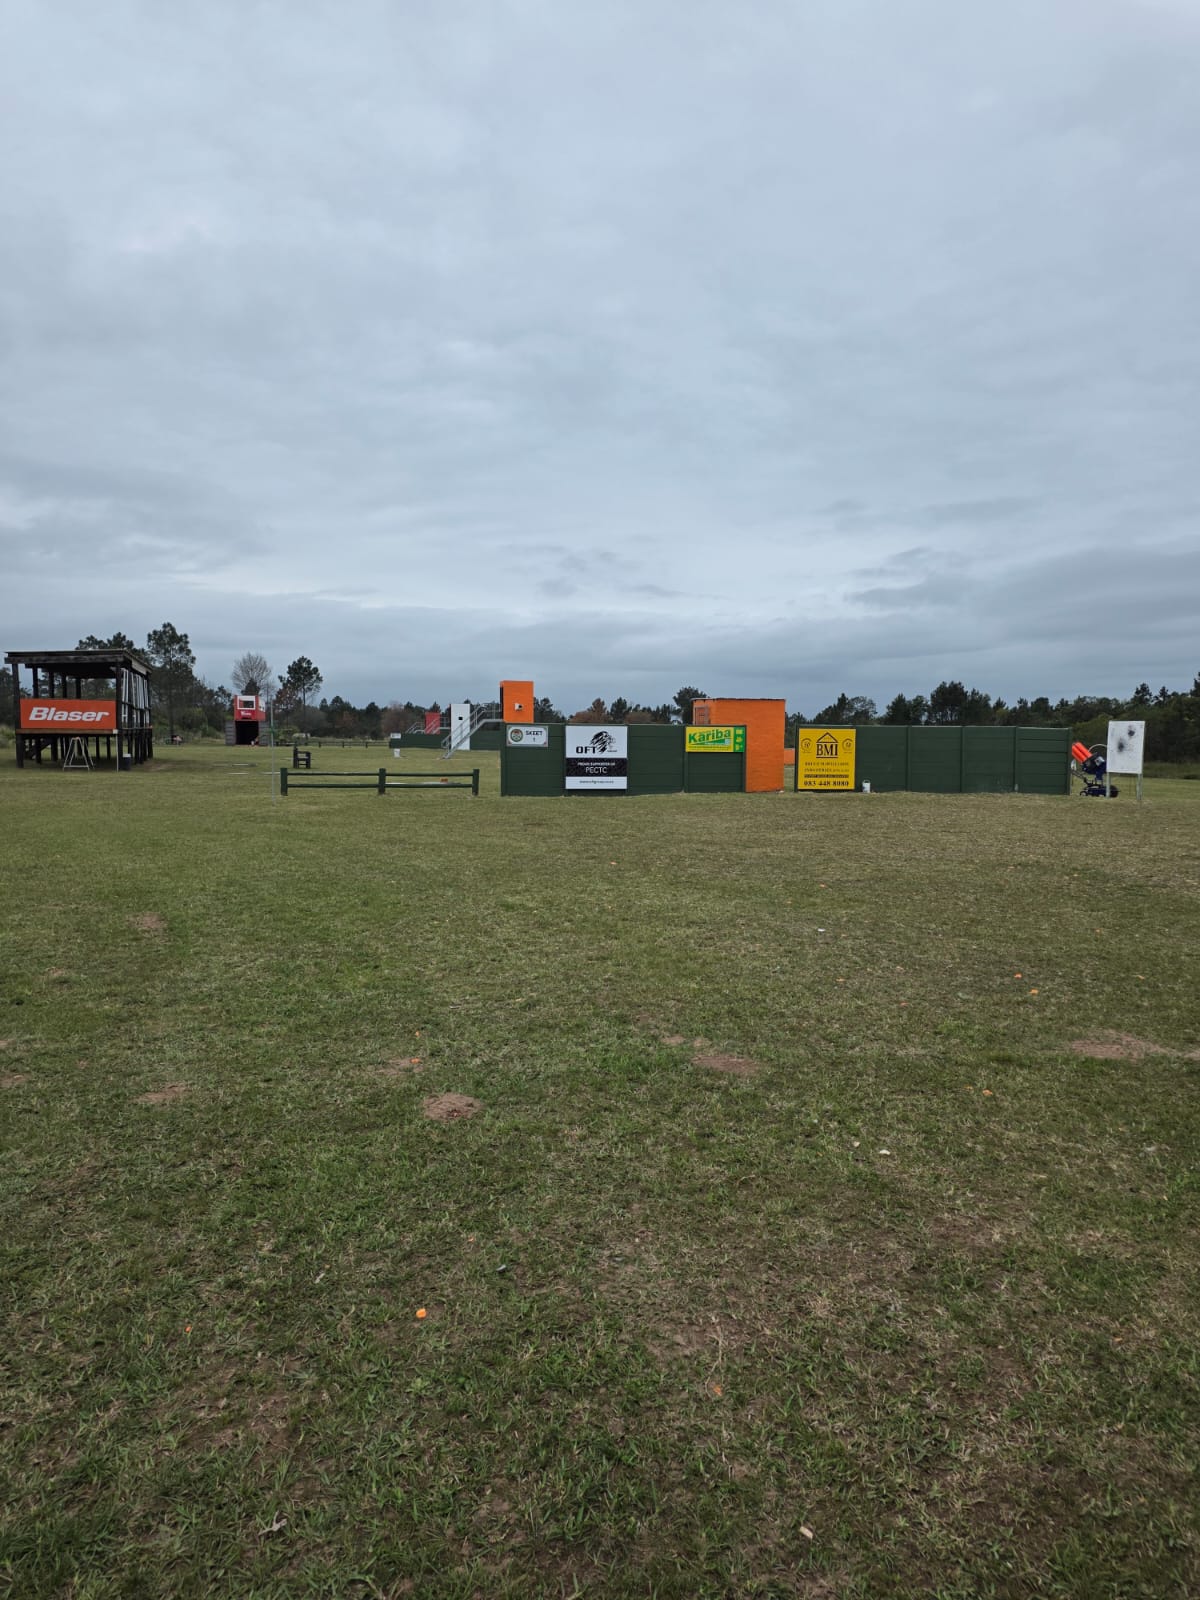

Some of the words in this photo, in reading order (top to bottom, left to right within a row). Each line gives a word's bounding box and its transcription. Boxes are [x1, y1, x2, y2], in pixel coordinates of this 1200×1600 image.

[29, 706, 110, 722] Blaser
[688, 729, 731, 744] Kariba
[576, 746, 596, 754] OFT
[816, 743, 838, 756] BMI
[585, 766, 608, 774] PECTC
